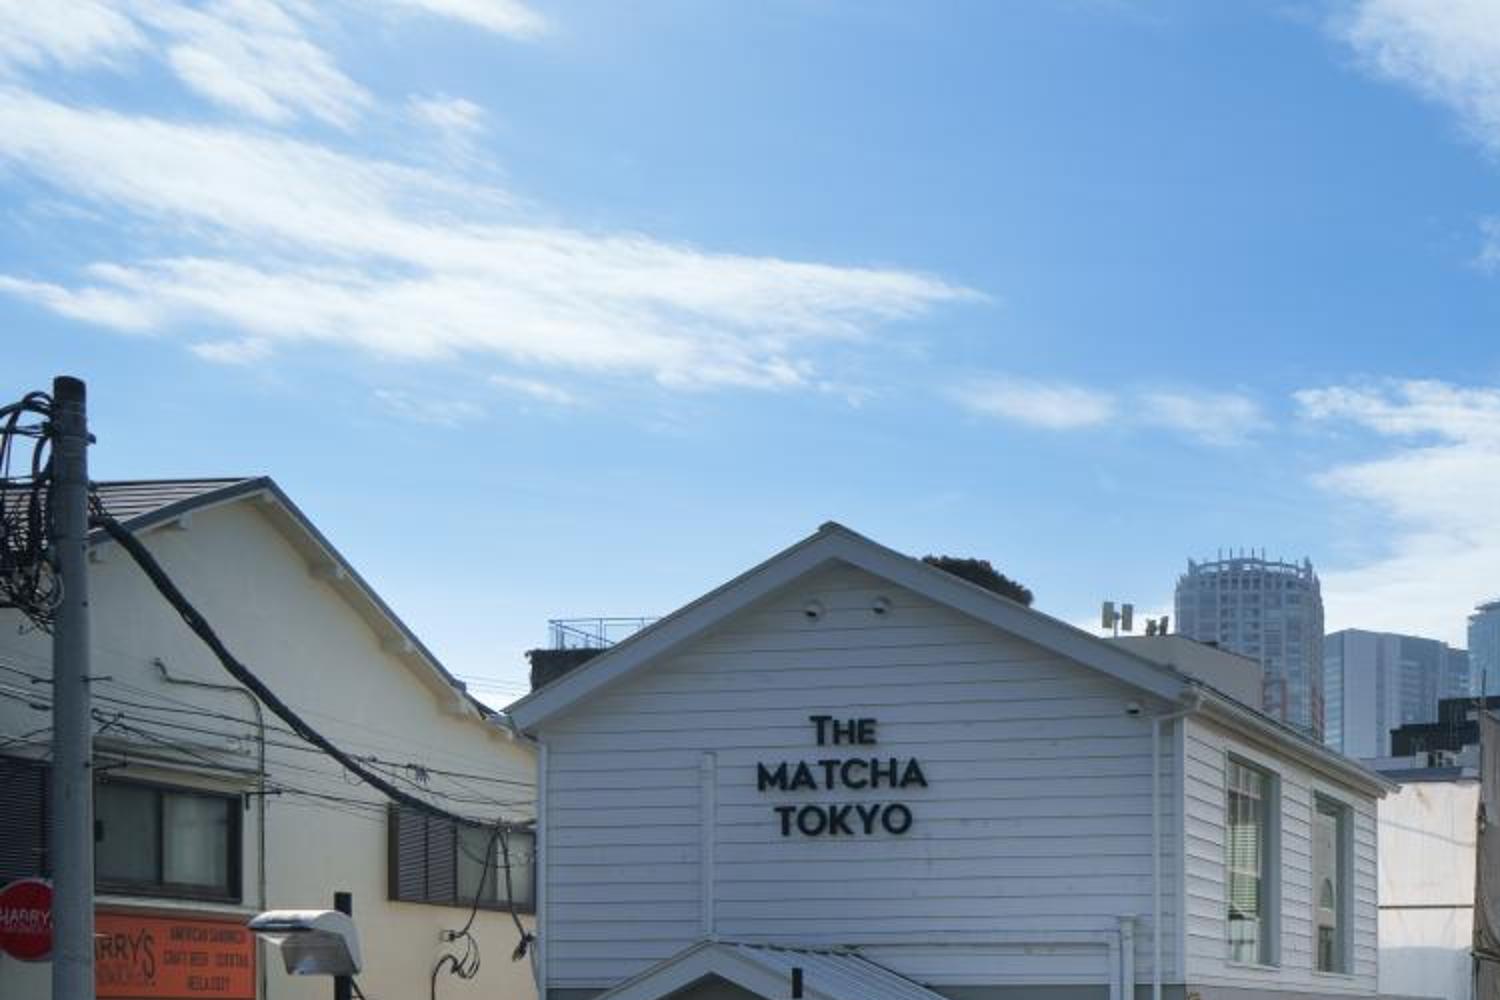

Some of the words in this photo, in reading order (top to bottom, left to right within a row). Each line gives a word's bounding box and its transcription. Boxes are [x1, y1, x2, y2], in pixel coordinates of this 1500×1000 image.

[756, 757, 928, 791] MATCHA
[773, 803, 913, 836] TOKYO
[0, 907, 53, 928] HARRY
